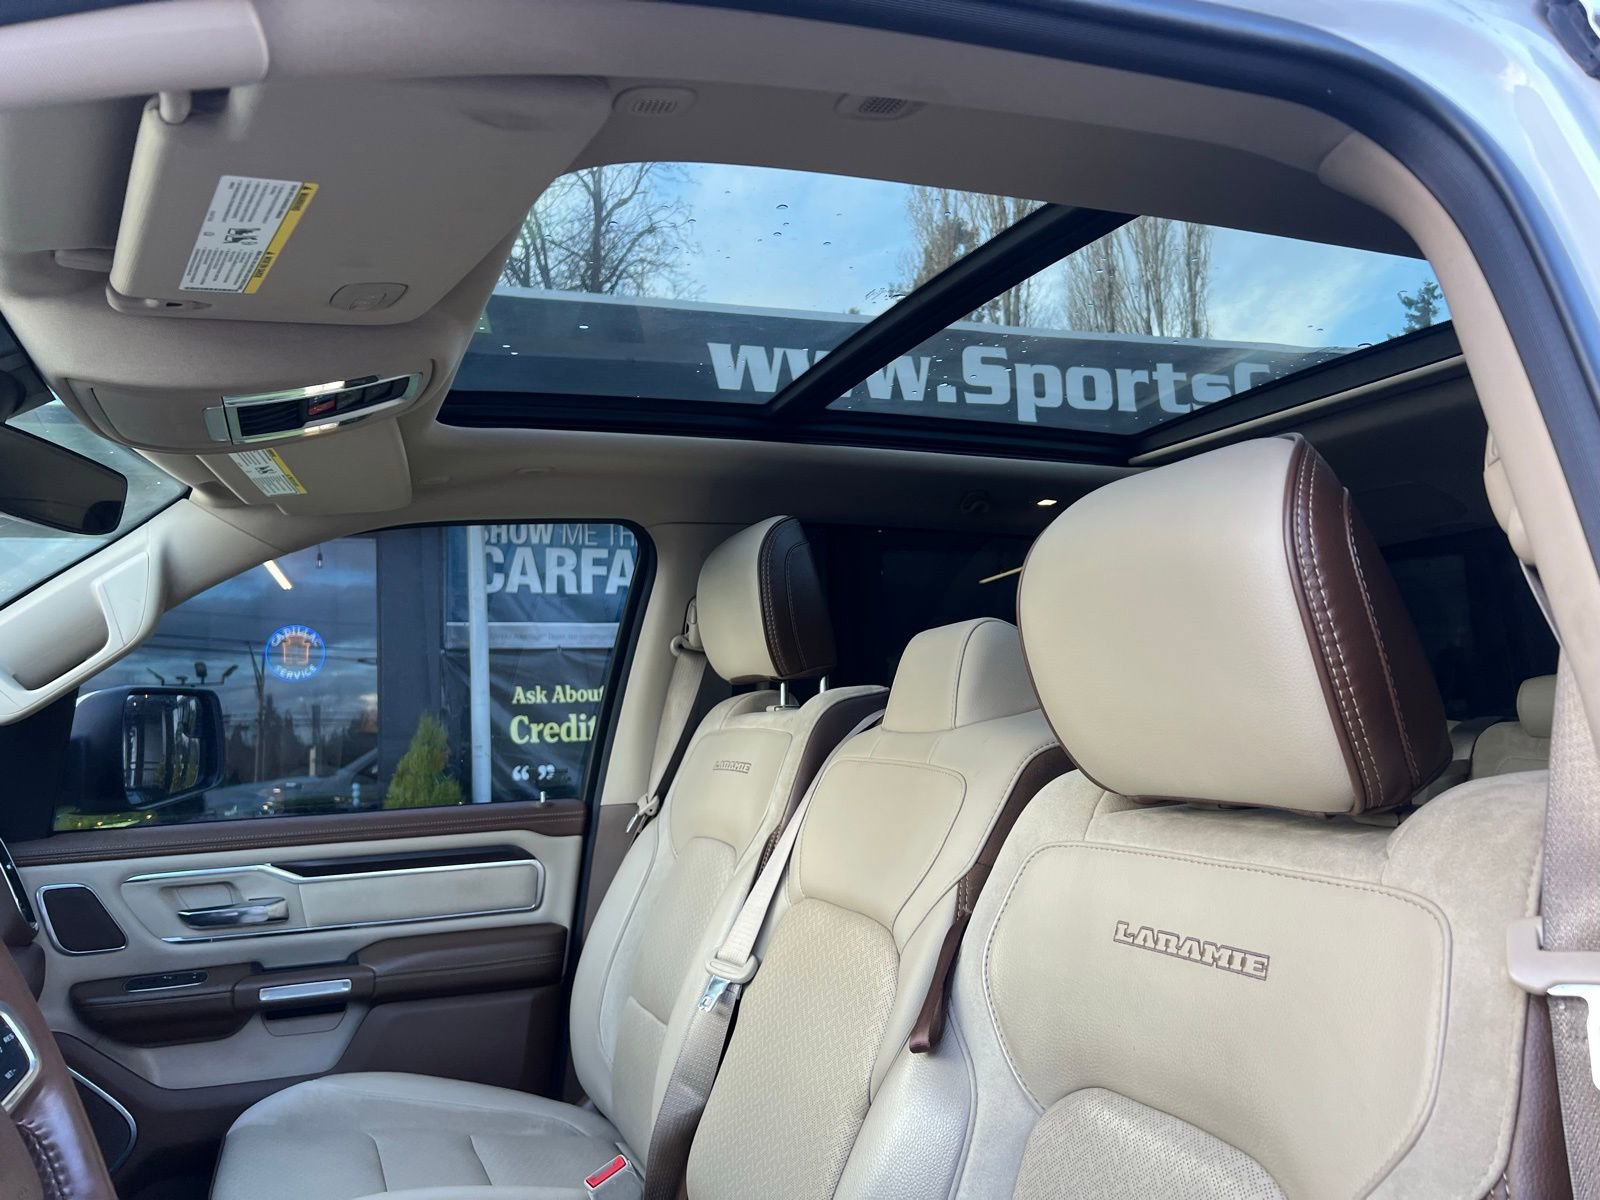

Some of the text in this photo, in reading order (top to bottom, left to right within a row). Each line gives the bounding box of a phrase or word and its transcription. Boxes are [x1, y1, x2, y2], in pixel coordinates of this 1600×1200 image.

[485, 524, 638, 547] HOW ME TH
[486, 545, 636, 595] CARFA
[276, 664, 317, 680] SERVICE
[512, 685, 548, 705] Ask
[510, 713, 597, 745] Credit
[1113, 920, 1270, 982] LARAMIE
